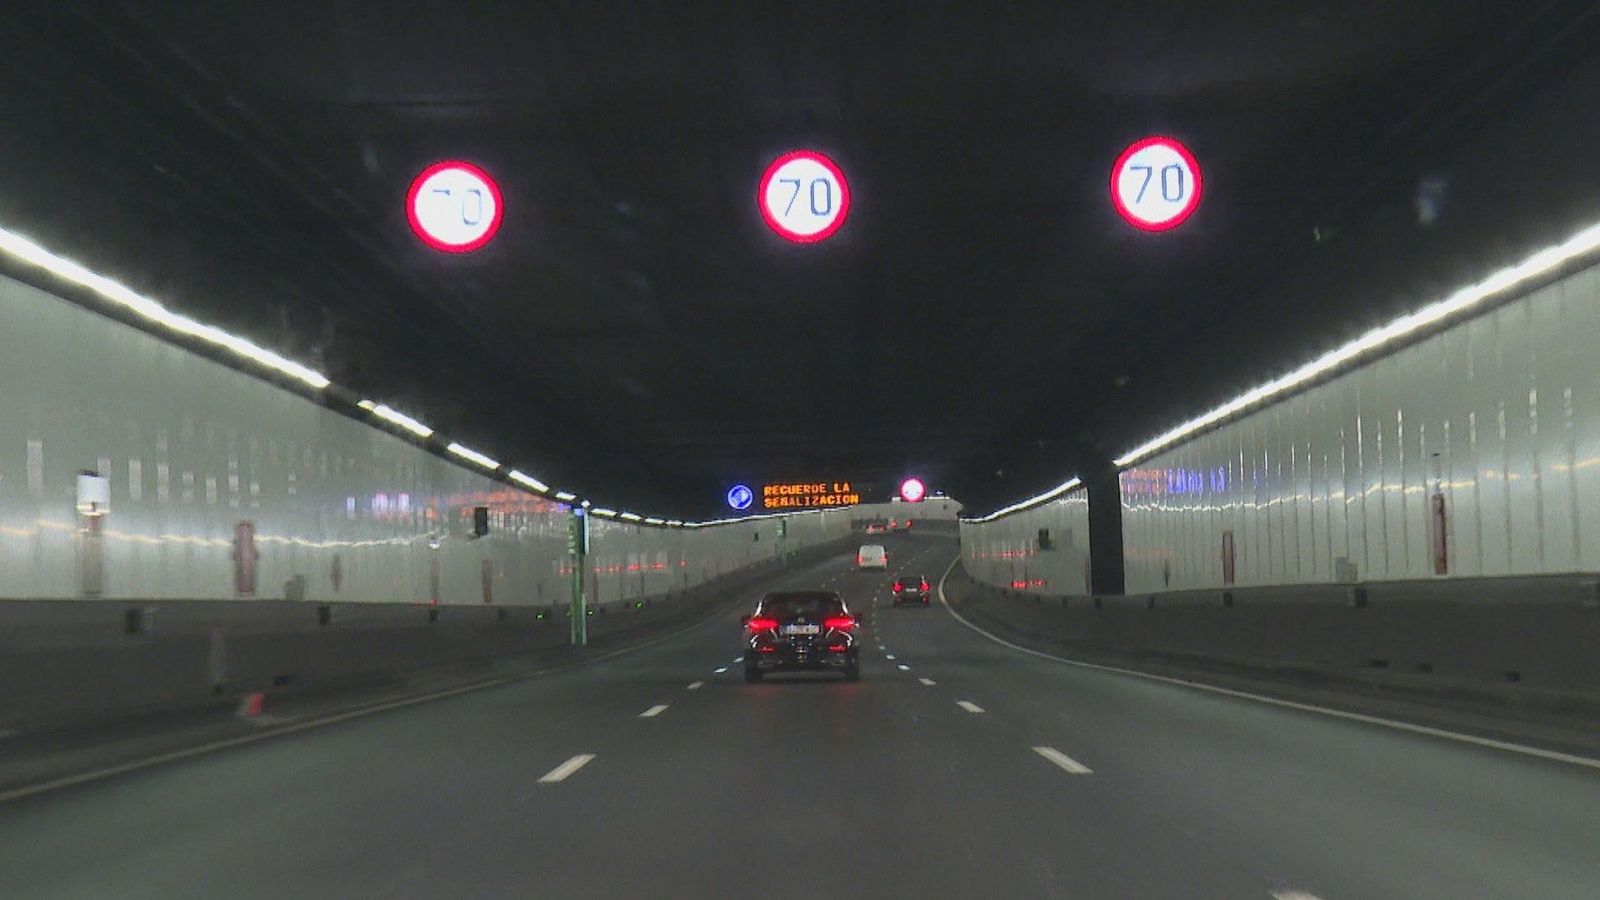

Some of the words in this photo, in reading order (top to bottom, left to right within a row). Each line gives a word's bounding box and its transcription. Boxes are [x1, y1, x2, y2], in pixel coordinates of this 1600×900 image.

[779, 178, 832, 217] 70
[1129, 164, 1184, 204] 70
[764, 483, 827, 496] RECUERDE
[834, 482, 850, 493] LA
